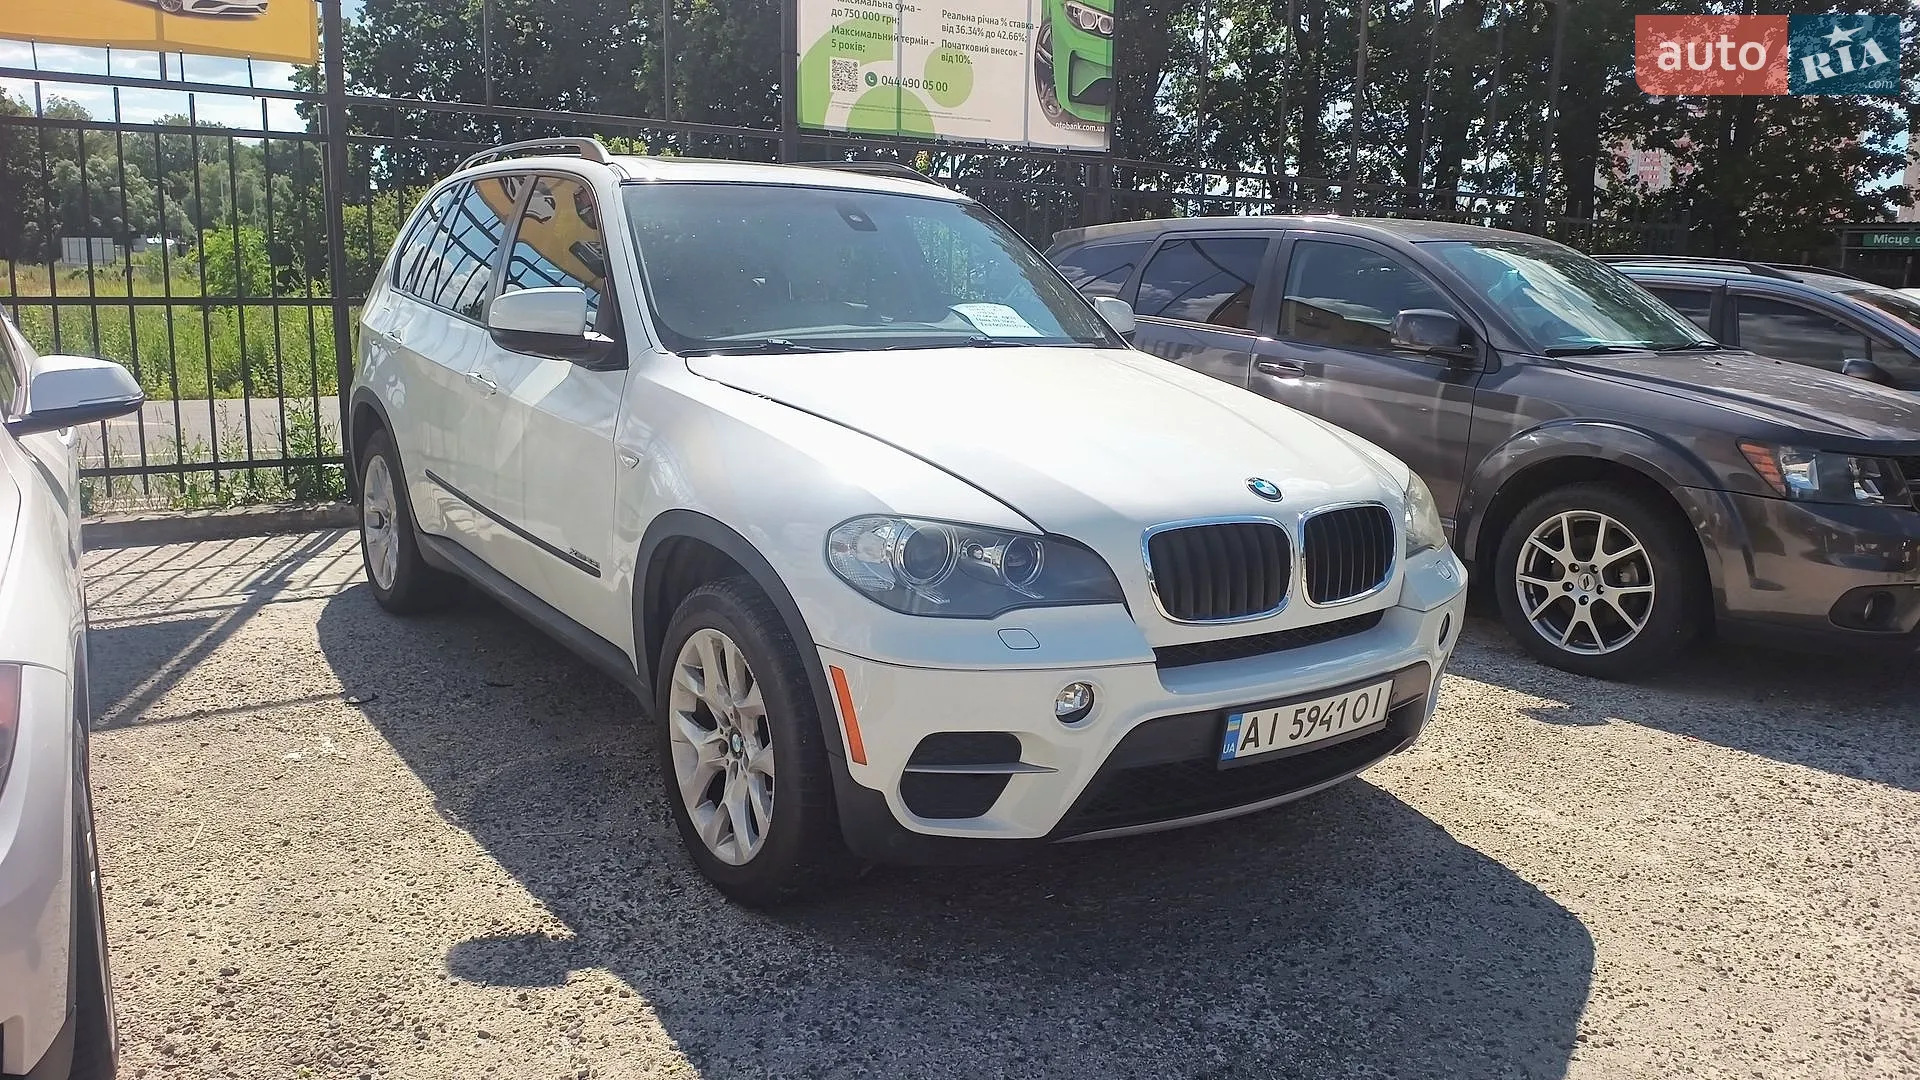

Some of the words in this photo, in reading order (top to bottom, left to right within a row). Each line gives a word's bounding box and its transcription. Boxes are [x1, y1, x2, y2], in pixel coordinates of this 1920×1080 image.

[837, 0, 893, 9] ксимальна
[894, 4, 915, 13] сума
[831, 8, 843, 18] до
[844, 8, 860, 19] 750
[862, 10, 880, 21] 000
[882, 15, 900, 26] грн;
[942, 9, 976, 22] Реальна
[977, 14, 999, 25] річна
[1009, 20, 1034, 30] ставка
[831, 24, 899, 42] Максимальний
[900, 34, 929, 46] термін
[941, 23, 954, 34] від
[955, 24, 985, 37] 36.34%
[985, 31, 996, 39] до
[831, 38, 837, 48] 5
[838, 41, 866, 52] років;
[941, 39, 989, 54] Початковий
[990, 47, 1018, 57] внесок
[941, 53, 954, 64] від
[955, 54, 973, 65] 10%.
[881, 75, 900, 88] 044
[902, 78, 920, 89] 490
[922, 80, 934, 91] 05
[935, 81, 948, 92] 00
[1873, 234, 1910, 246] Місце
[1288, 697, 1349, 741] 5941
[1223, 743, 1236, 755] UA
